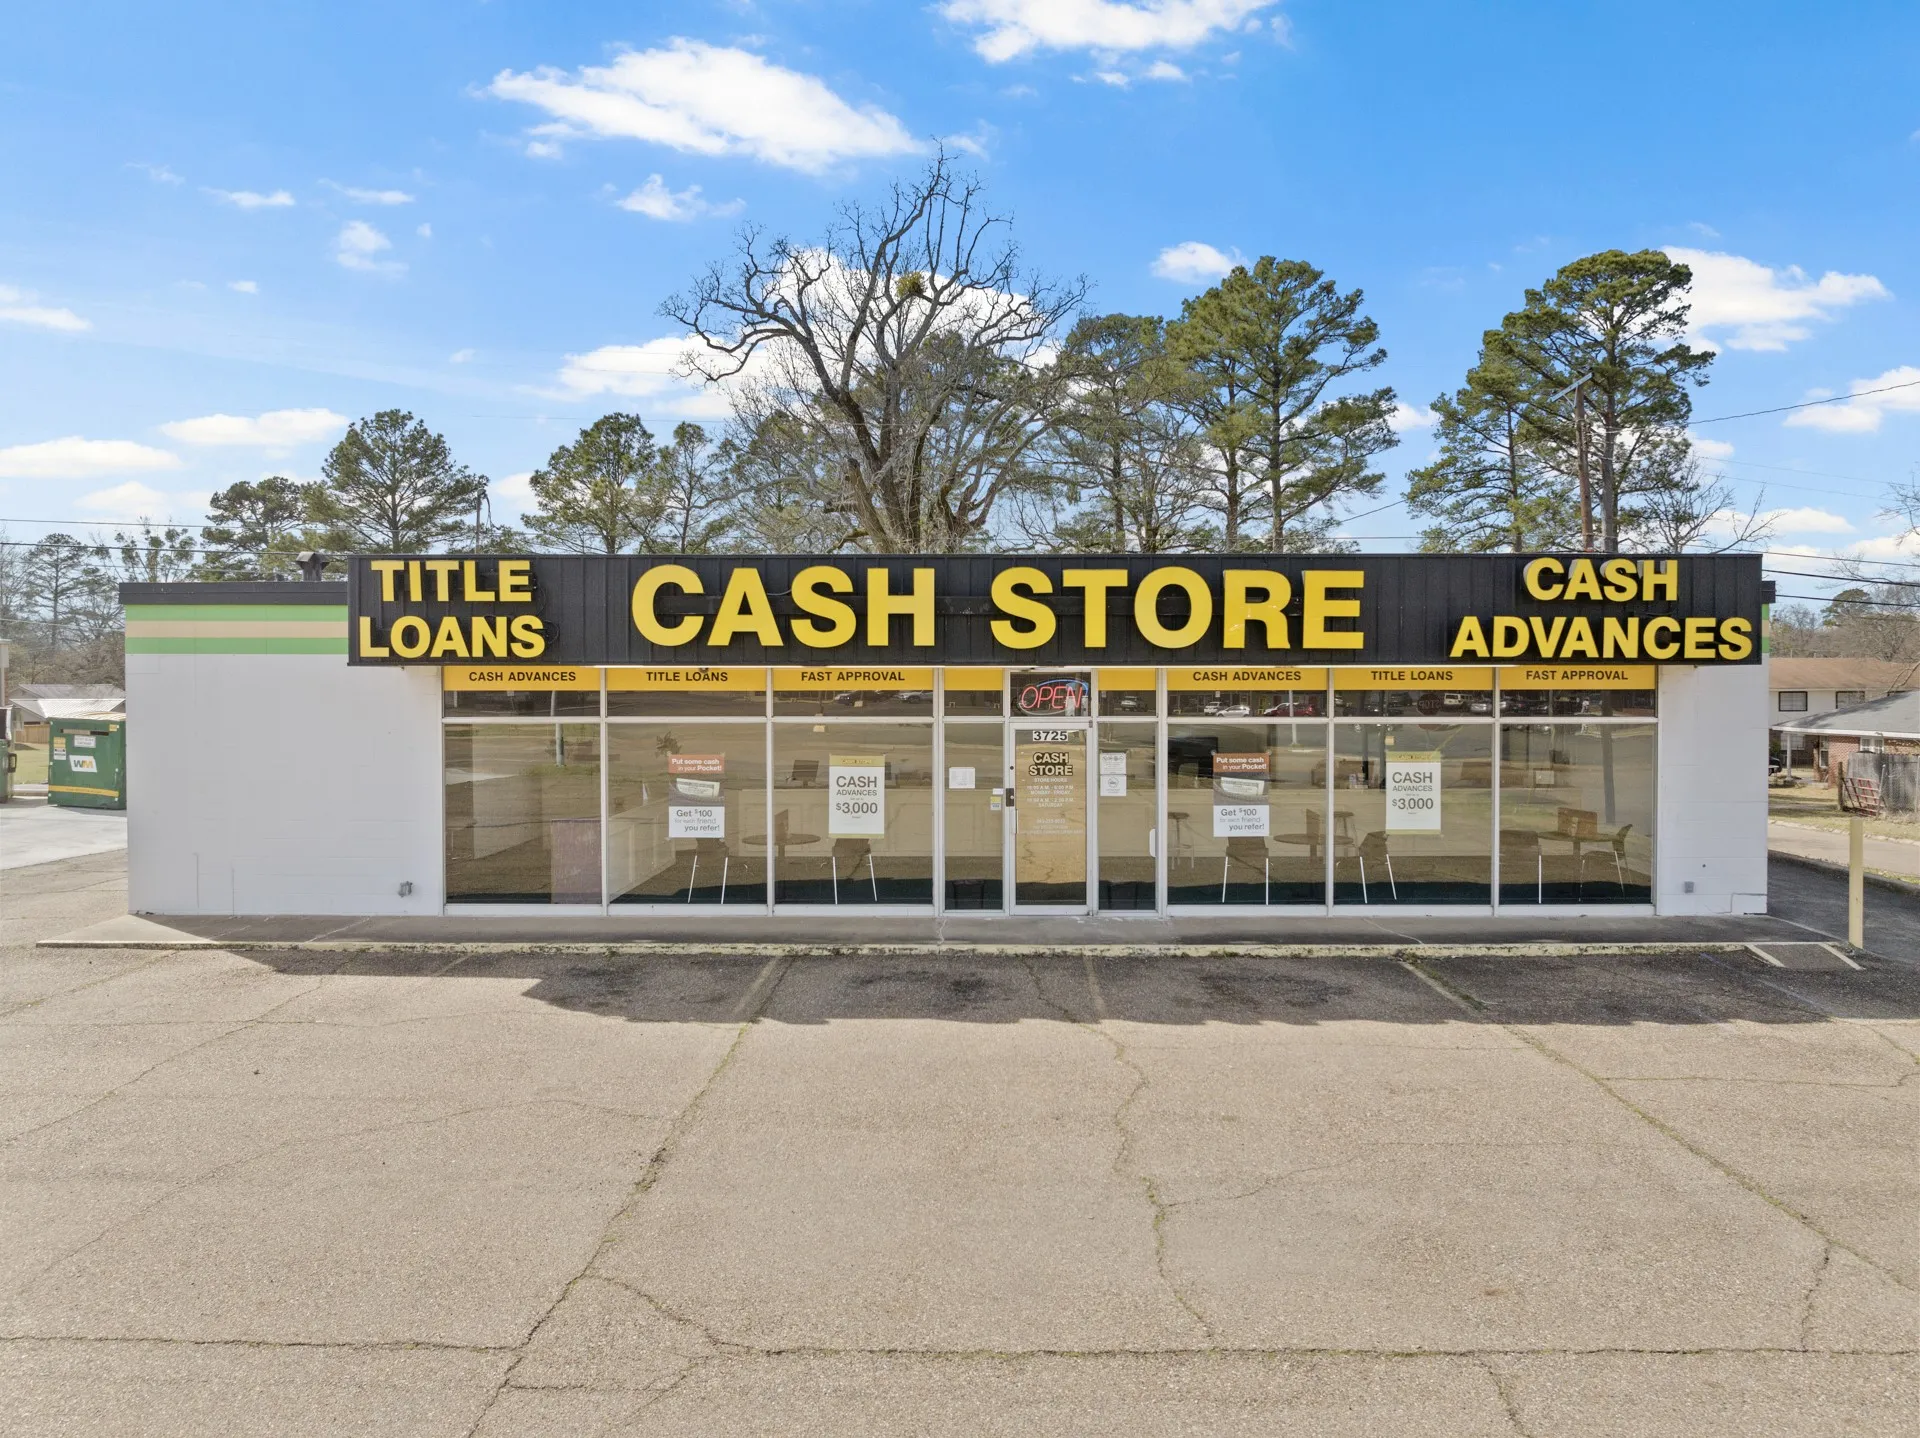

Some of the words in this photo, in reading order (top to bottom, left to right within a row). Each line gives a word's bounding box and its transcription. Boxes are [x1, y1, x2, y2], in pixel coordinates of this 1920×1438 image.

[371, 559, 533, 602] TITLE
[1523, 557, 1679, 602] CASH
[631, 564, 936, 648] CASH
[989, 566, 1365, 650] STORE
[358, 615, 546, 659] LOANS
[1449, 615, 1754, 661] ADVANCES
[468, 671, 504, 682] CASH
[507, 671, 577, 682] ADVANCES
[645, 671, 681, 682] TITLE
[685, 671, 729, 682] LOANS
[801, 671, 833, 682] FAST
[836, 671, 906, 682] APPROVAL
[1192, 671, 1228, 682] CASH
[1232, 670, 1302, 682] ADVANCES
[1370, 670, 1406, 681] TITLE
[1410, 670, 1454, 681] LOANS
[1525, 670, 1558, 681] FAST
[1560, 670, 1629, 681] APPROVAL
[1021, 686, 1083, 709] OPEN
[1033, 730, 1068, 741] 3725
[1033, 752, 1069, 764] CASH
[73, 760, 94, 769] WM
[1029, 765, 1073, 776] STORE
[836, 776, 877, 788] CASH
[1392, 771, 1433, 784] CASH
[835, 802, 878, 815] $3,000
[1391, 797, 1434, 811] $3,000
[676, 809, 693, 817] Get
[694, 808, 713, 817] $100
[1220, 808, 1237, 817] Get
[1238, 807, 1257, 816] $100
[684, 824, 699, 832] you
[1229, 823, 1244, 832] you
